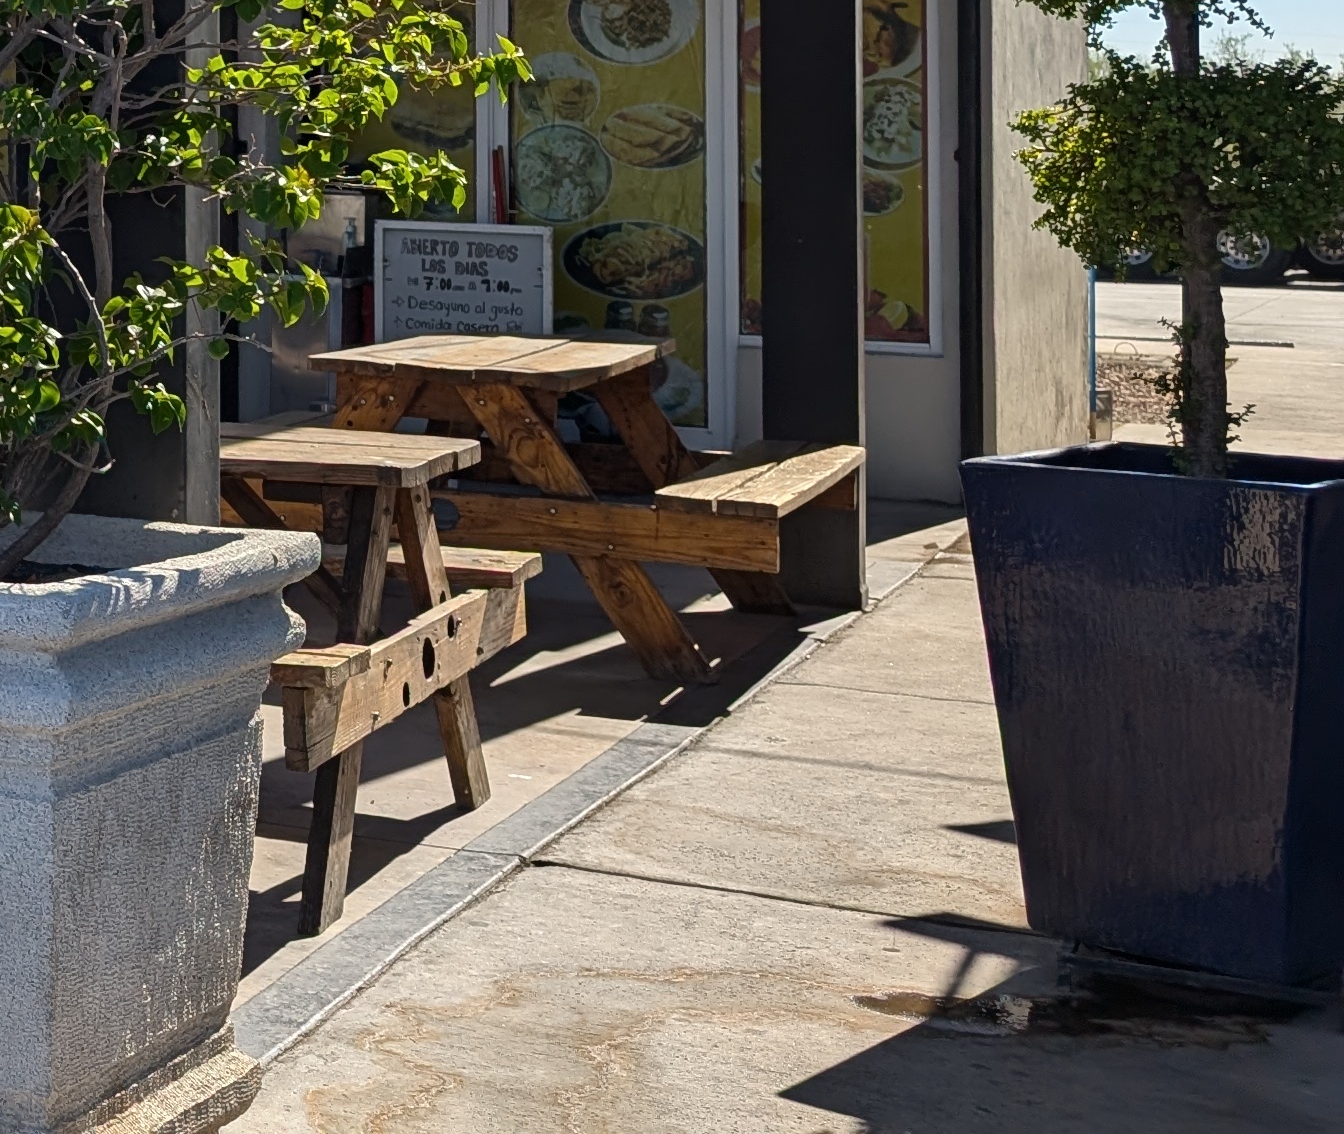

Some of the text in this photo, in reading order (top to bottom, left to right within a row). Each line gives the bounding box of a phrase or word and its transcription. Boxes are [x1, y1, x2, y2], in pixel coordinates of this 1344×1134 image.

[401, 237, 518, 262] ABIERTO TODOS
[422, 258, 488, 277] LOS DIAS
[408, 295, 523, 321] Desayuno al gusto
[405, 317, 451, 330] Comida
